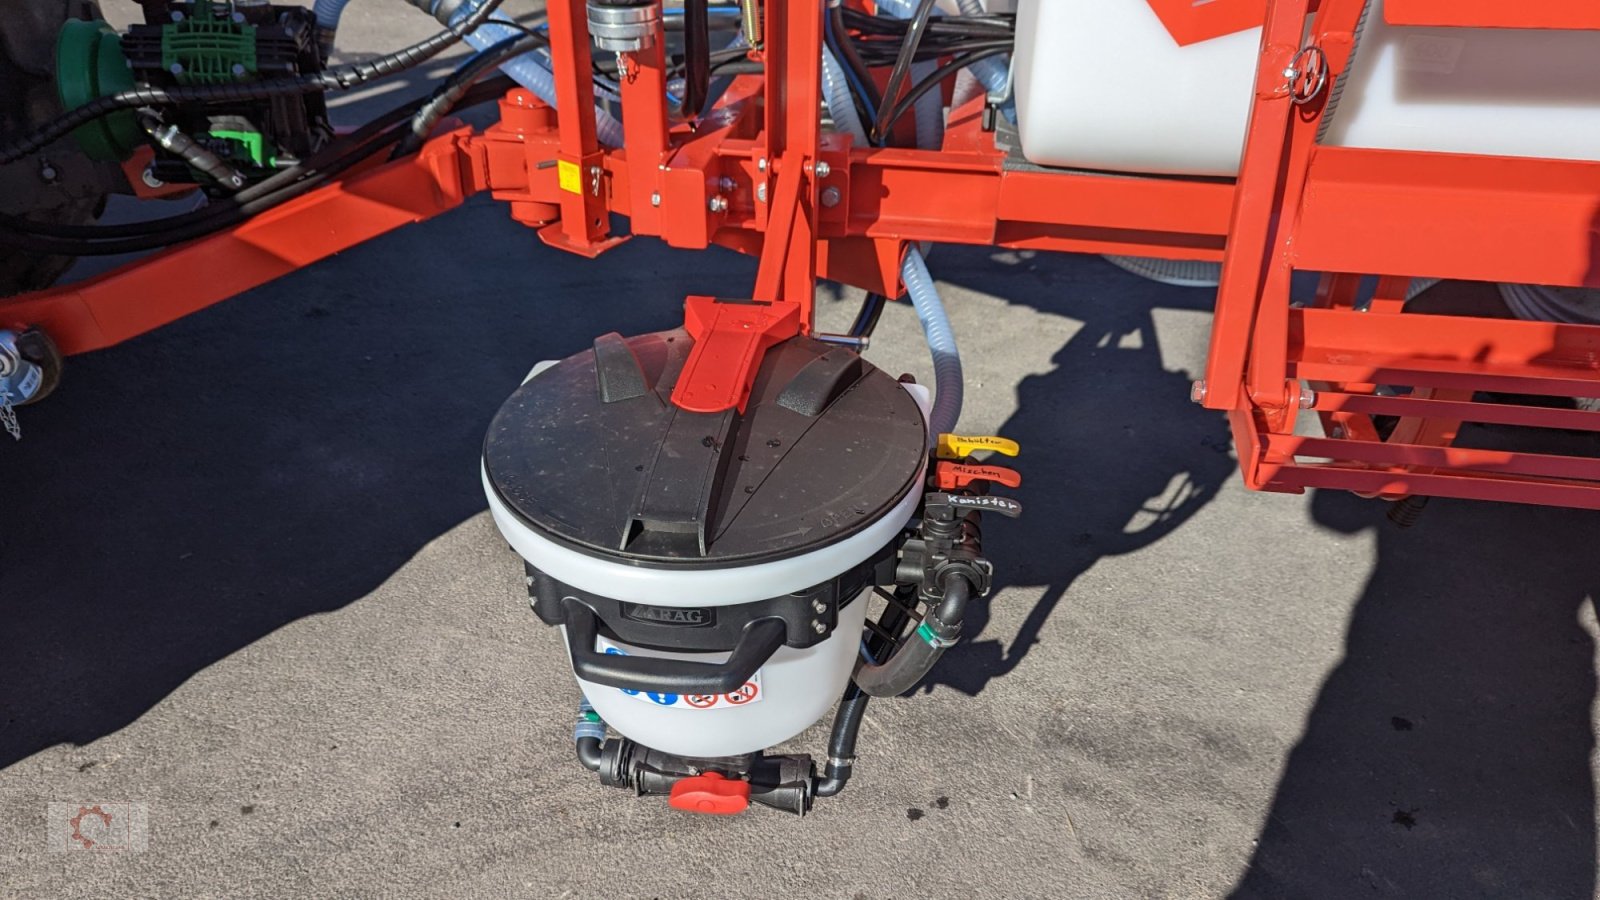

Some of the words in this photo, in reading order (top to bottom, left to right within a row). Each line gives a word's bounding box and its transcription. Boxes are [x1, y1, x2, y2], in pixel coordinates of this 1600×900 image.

[952, 465, 1001, 479] Mischen
[947, 494, 1018, 510] Kanister
[643, 606, 703, 623] ARAG
